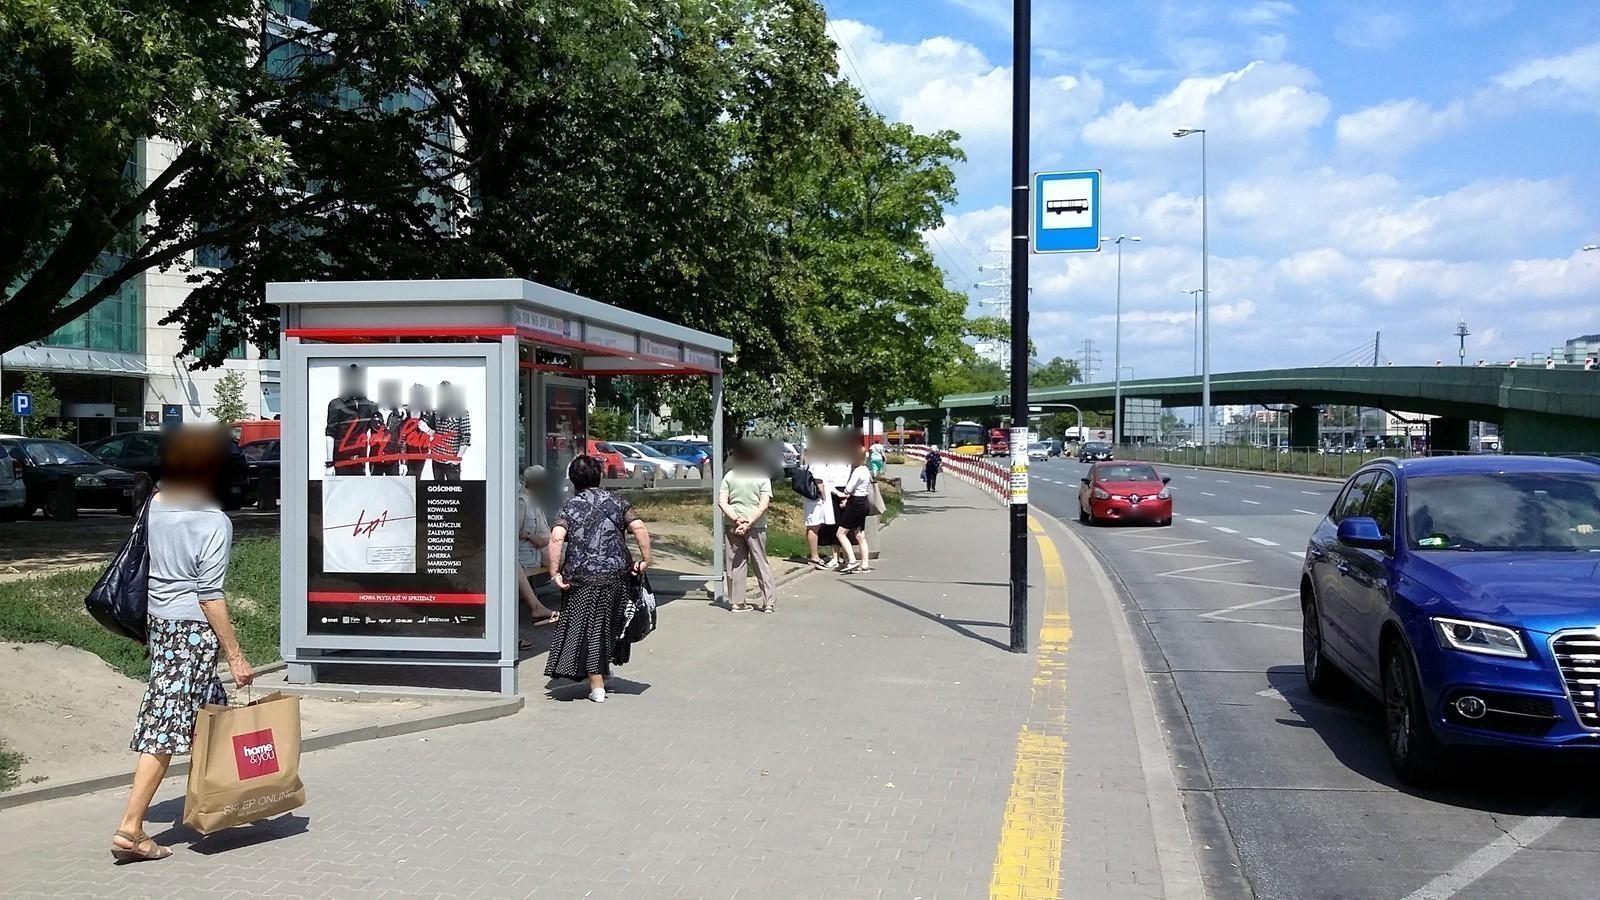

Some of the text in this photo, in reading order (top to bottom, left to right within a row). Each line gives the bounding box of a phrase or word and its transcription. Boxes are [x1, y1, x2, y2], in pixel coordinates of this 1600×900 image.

[17, 395, 29, 413] P
[243, 744, 273, 757] home
[250, 751, 275, 765] &you
[223, 798, 256, 815] SKLEP
